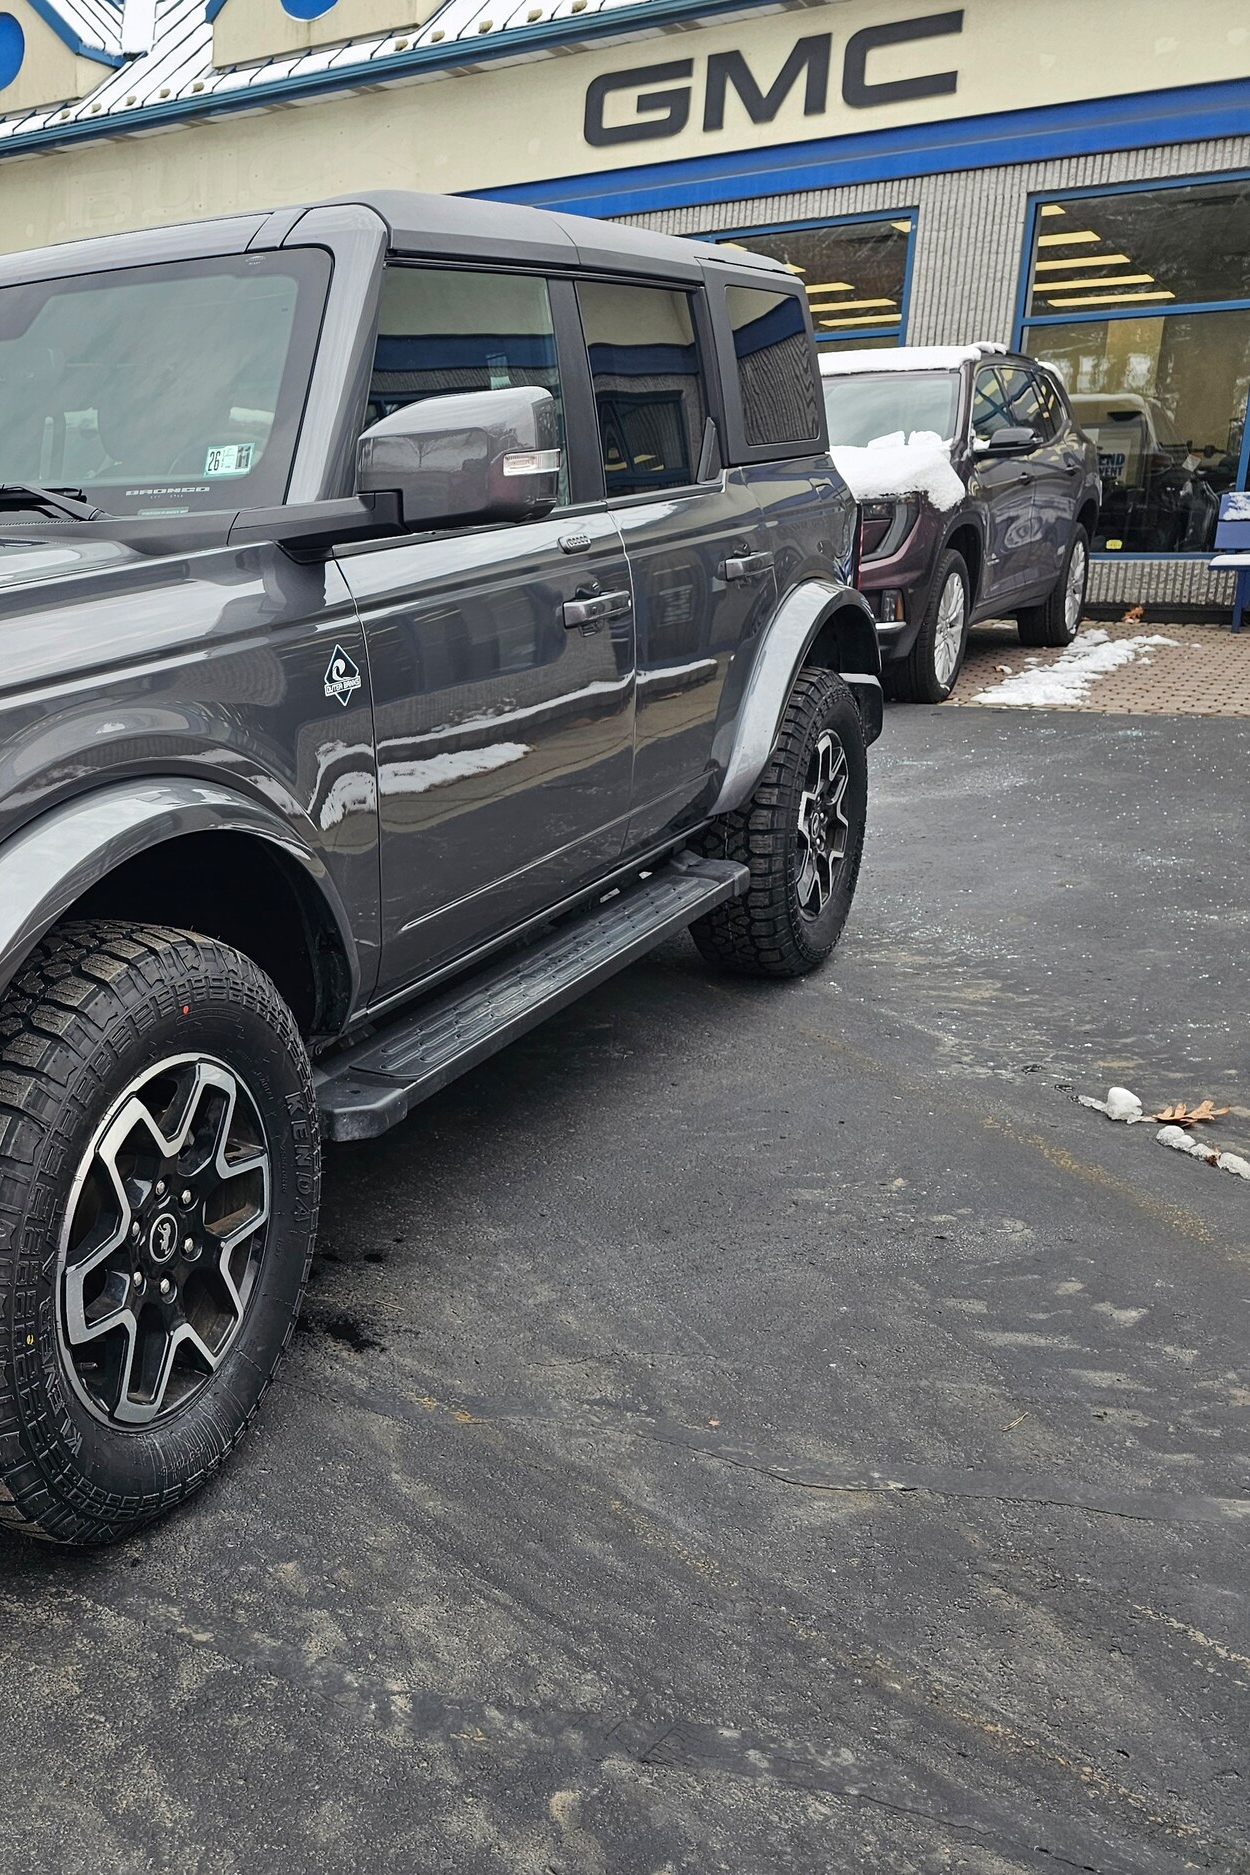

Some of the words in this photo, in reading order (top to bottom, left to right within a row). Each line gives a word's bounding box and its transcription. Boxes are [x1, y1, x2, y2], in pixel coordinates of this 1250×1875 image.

[583, 9, 964, 147] GMC
[208, 450, 221, 472] 26
[1098, 466, 1124, 477] VENT
[326, 682, 343, 694] OUTER
[343, 677, 361, 689] BANKS
[285, 1091, 312, 1222] KENDA
